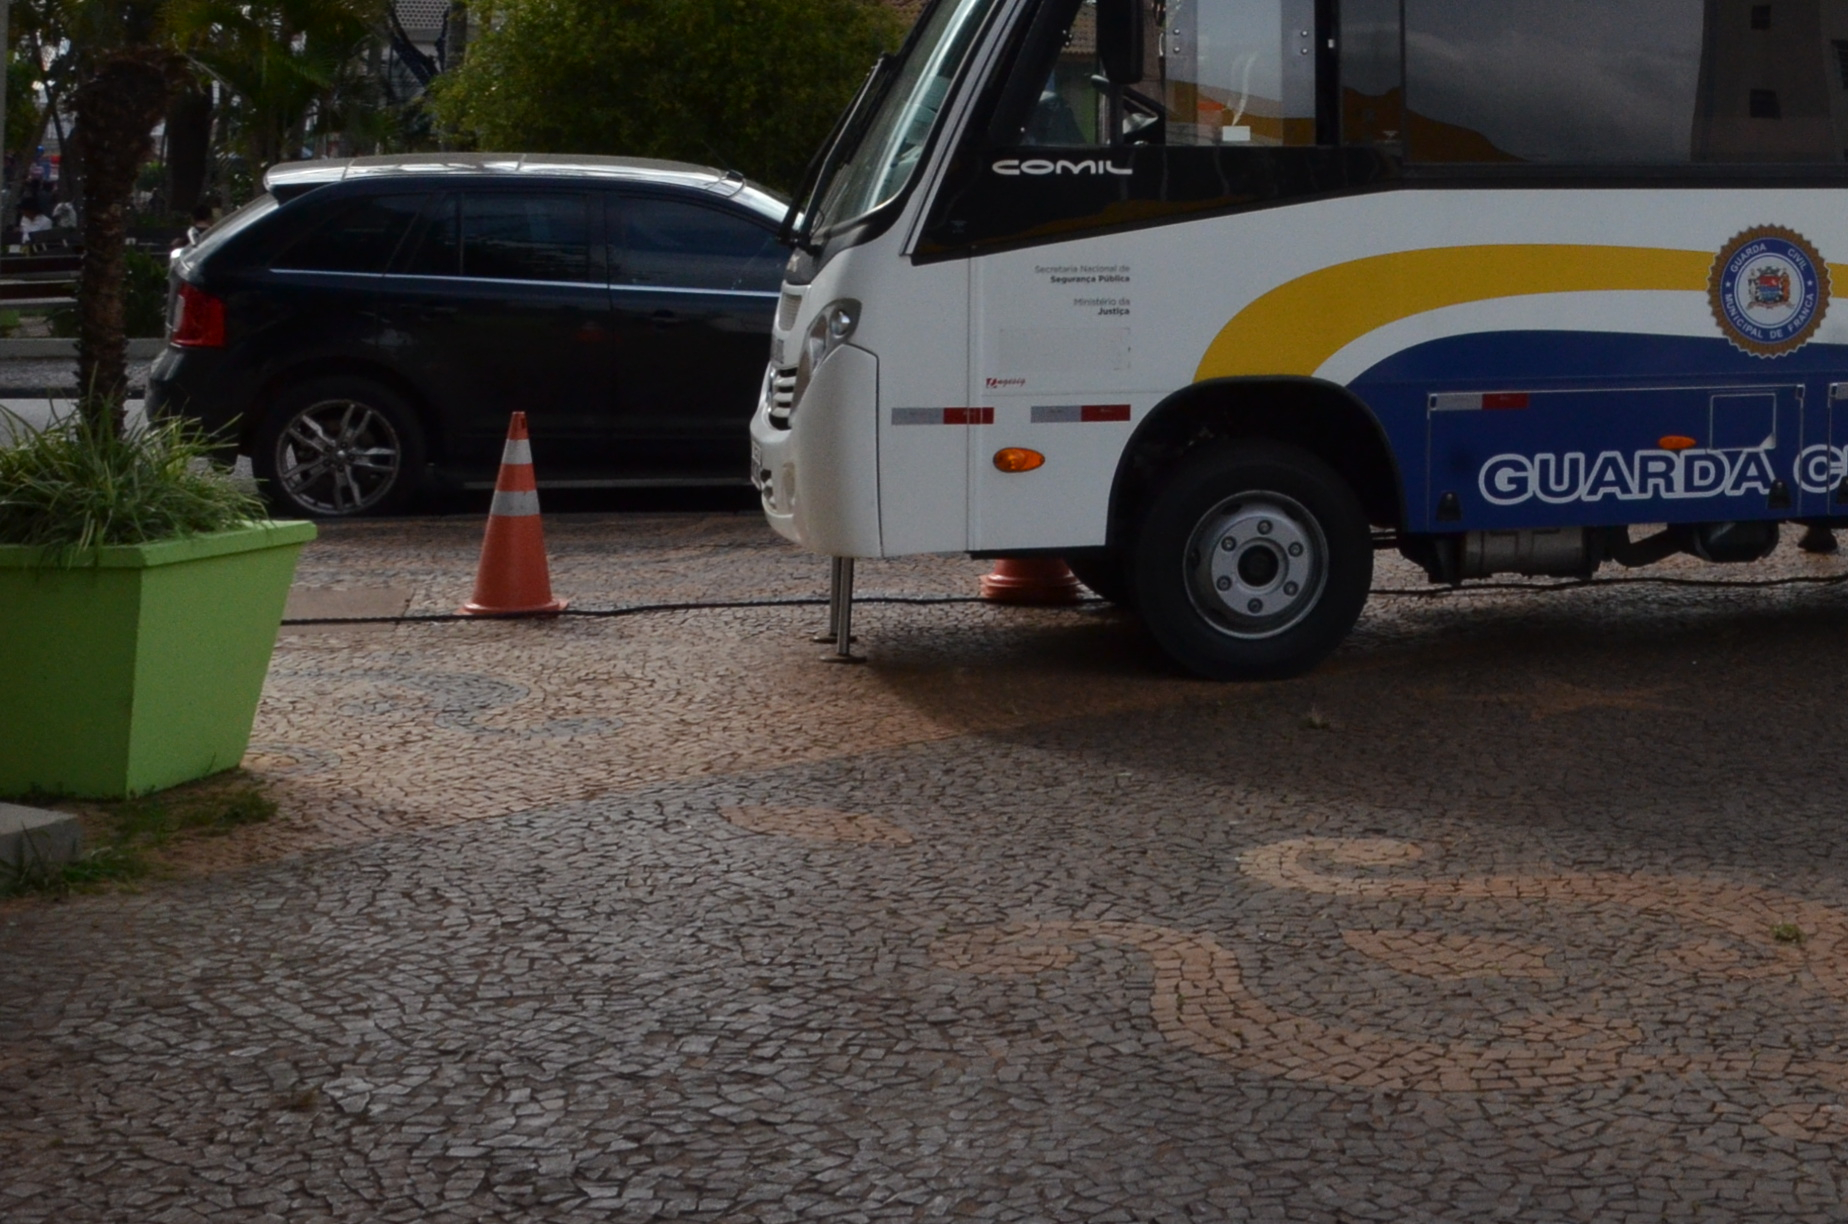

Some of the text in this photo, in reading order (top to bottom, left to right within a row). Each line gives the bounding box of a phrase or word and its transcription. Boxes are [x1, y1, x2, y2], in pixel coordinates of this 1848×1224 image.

[992, 159, 1133, 175] COMIL
[1730, 243, 1808, 273] GUARDA CIVIL
[1035, 264, 1130, 274] Secretaria Nacional de
[1050, 274, 1130, 284] Segurança Pública
[1073, 297, 1130, 306] Ministério da
[1098, 307, 1130, 316] Justiça
[1725, 293, 1814, 339] MUNICIPAL DE FRANCA
[1479, 450, 1772, 505] GUARDA
